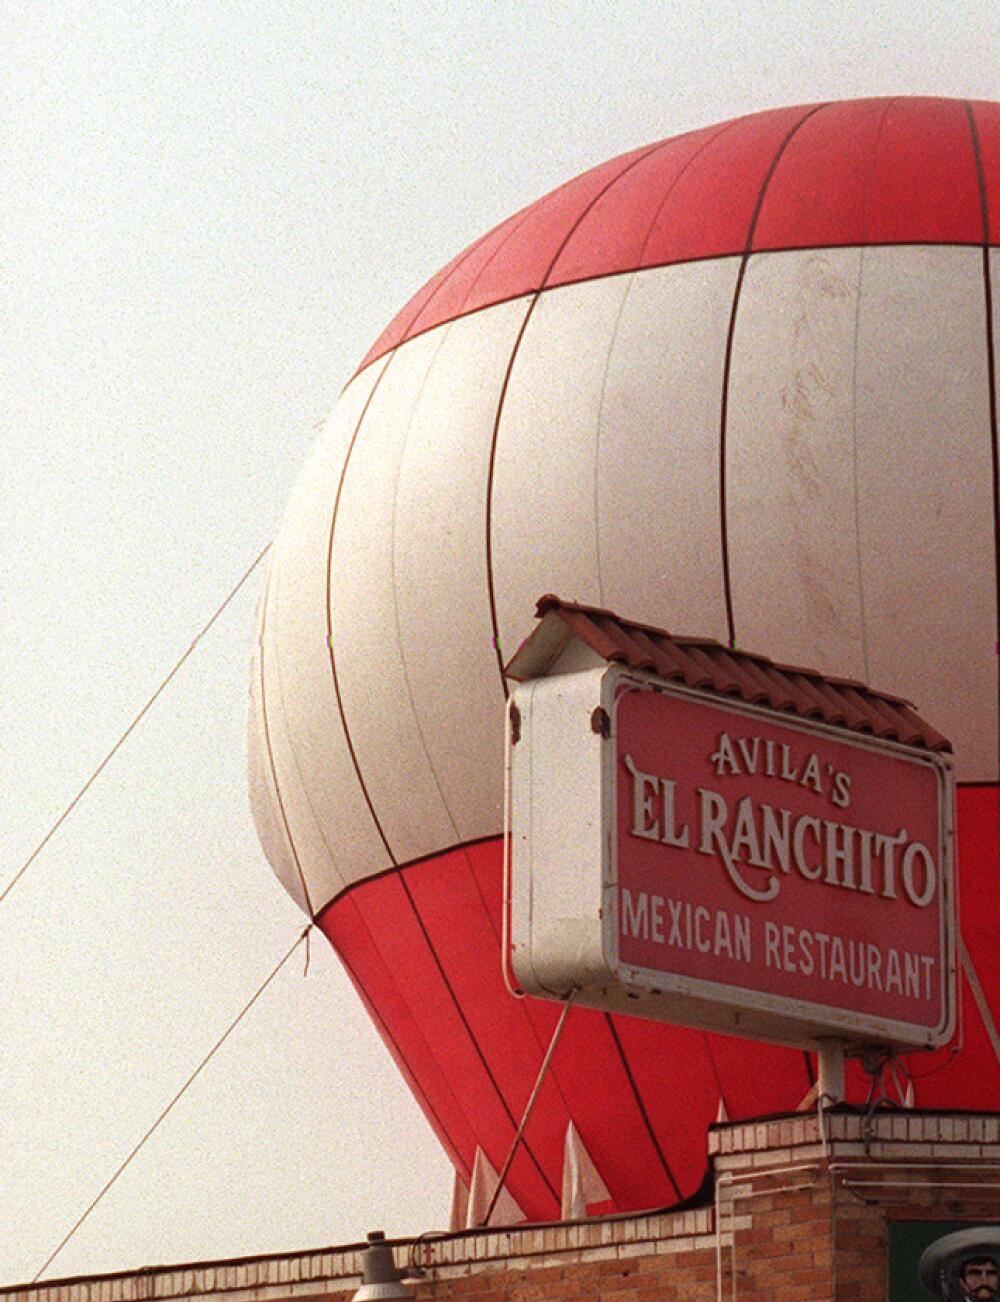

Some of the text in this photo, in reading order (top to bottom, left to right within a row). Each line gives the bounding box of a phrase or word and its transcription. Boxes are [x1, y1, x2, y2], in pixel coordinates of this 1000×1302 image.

[711, 732, 852, 808] AVILA'S
[625, 754, 936, 907] EL RANCHITO
[620, 887, 935, 1001] MEXICAN RESTAURANT
